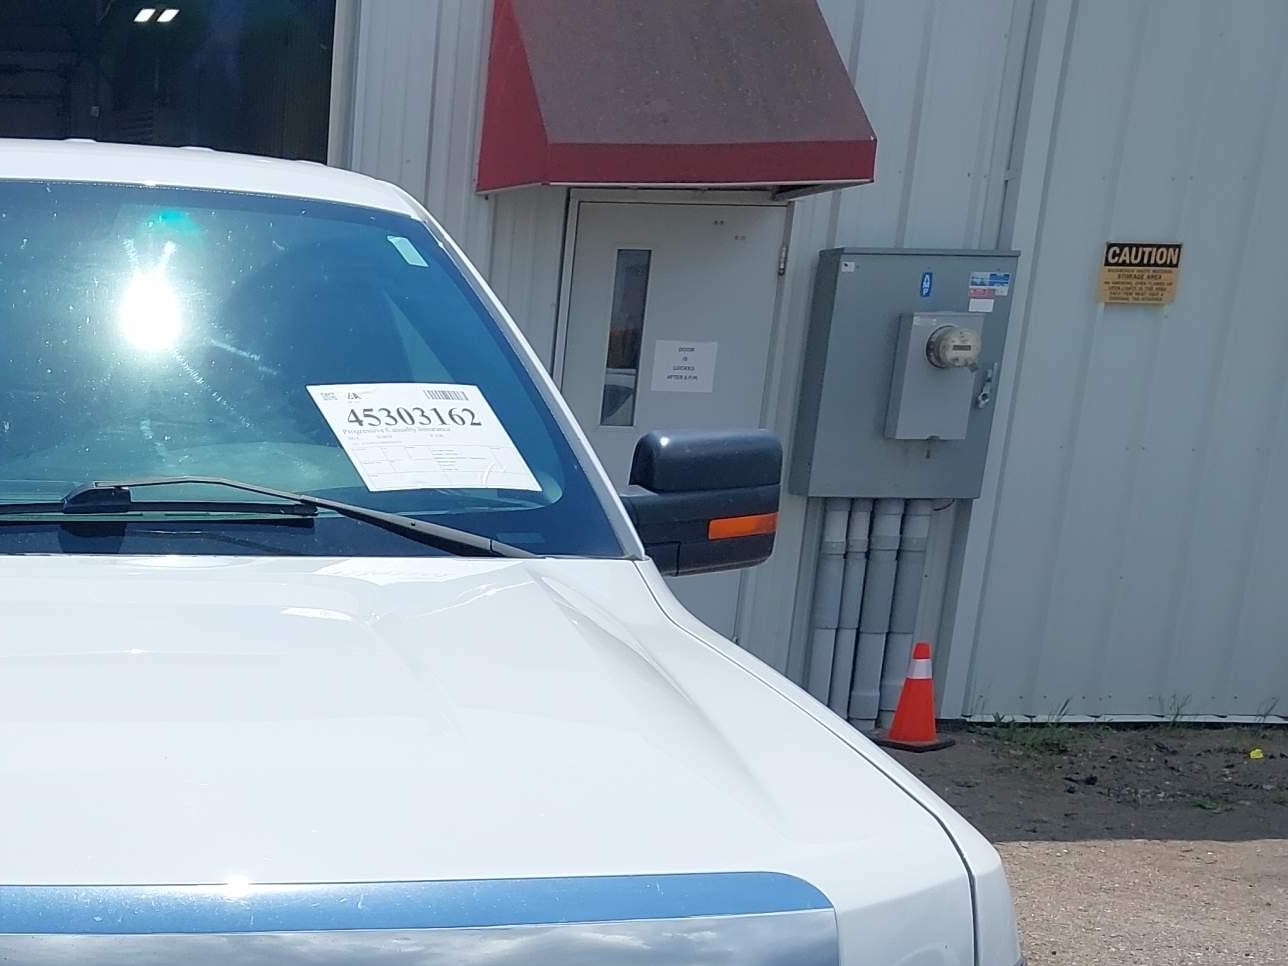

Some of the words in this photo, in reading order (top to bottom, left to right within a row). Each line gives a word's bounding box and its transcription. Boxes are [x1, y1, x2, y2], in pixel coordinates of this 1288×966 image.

[1107, 246, 1179, 265] CAUTION
[347, 407, 482, 427] 45303162
[342, 427, 385, 436] Progressive
[386, 426, 416, 434] Casualty
